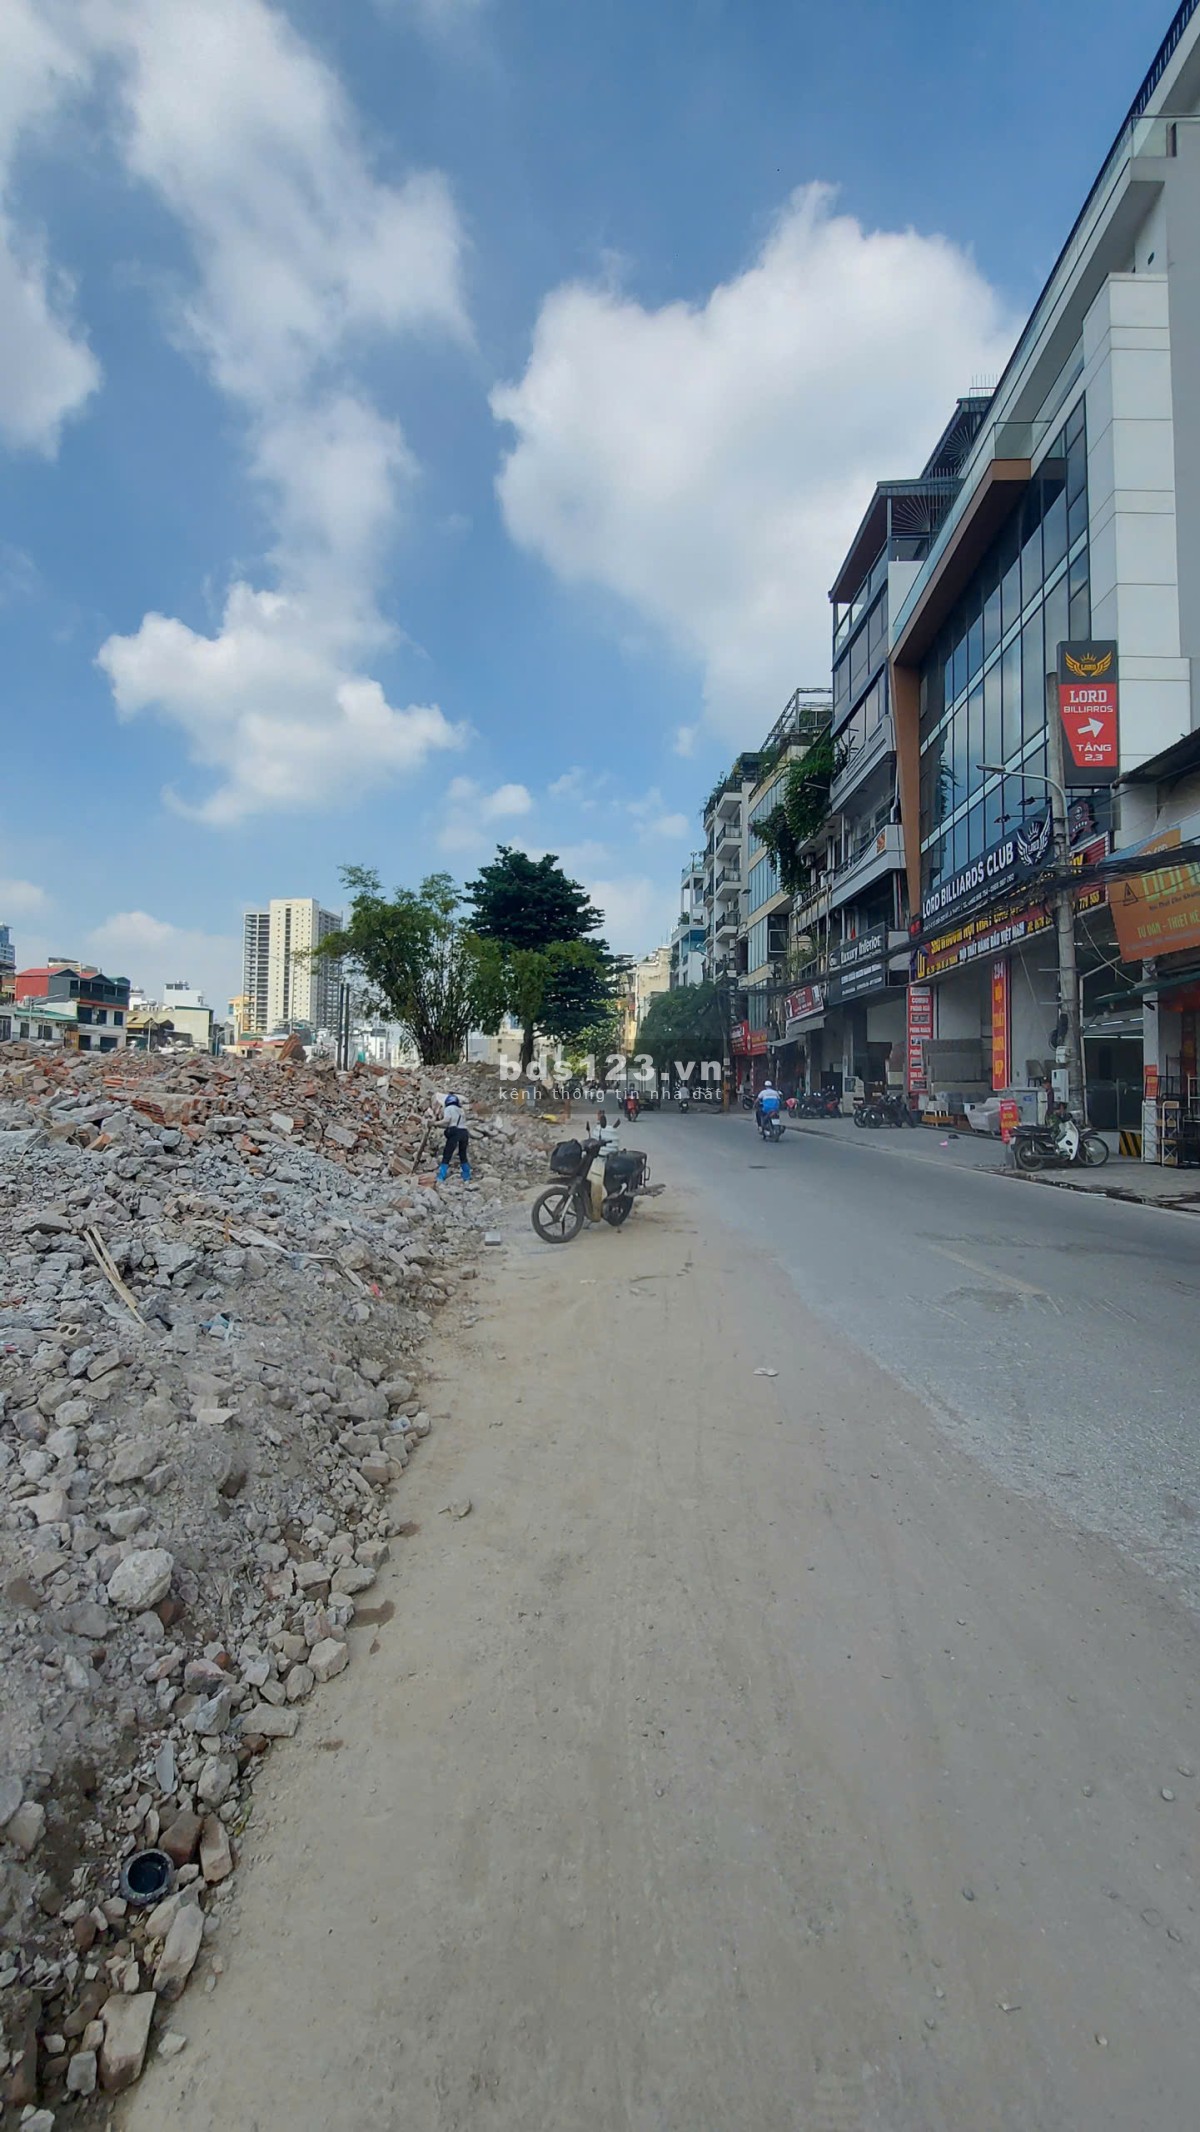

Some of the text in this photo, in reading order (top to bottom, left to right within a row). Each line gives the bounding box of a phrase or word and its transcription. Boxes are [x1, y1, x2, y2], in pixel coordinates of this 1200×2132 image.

[1069, 690, 1107, 703] LORD
[1063, 705, 1113, 713] BILLIARDS
[922, 892, 940, 919] LORD
[941, 861, 985, 907] BILLIARDS
[986, 841, 1014, 877] CLUB
